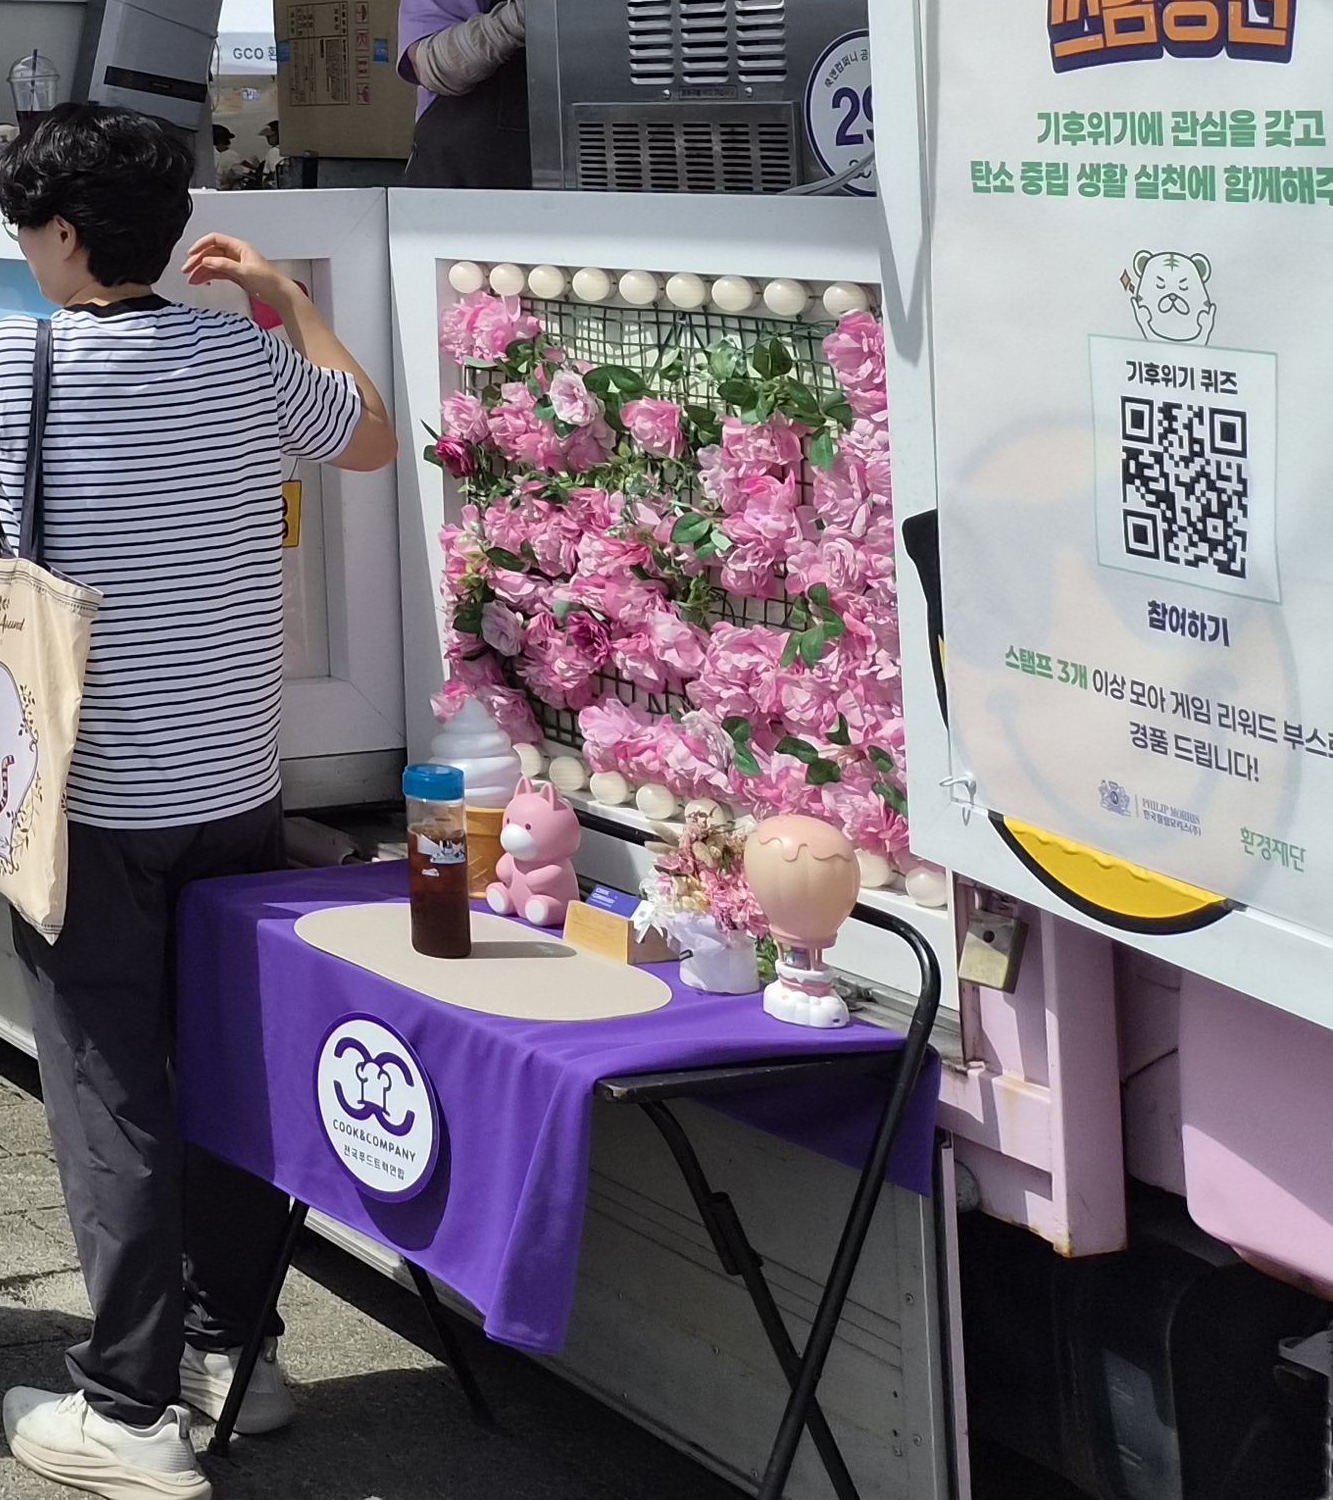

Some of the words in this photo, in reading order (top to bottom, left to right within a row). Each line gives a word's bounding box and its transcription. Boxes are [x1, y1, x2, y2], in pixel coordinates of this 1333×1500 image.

[233, 47, 264, 60] GCO
[1037, 111, 1164, 146] 기후위기에
[1171, 109, 1257, 147] 관심을
[1264, 110, 1326, 147] 갖고
[970, 160, 1015, 194] 탄소
[1019, 161, 1069, 196] 중립
[1076, 162, 1129, 198] 생활
[1134, 164, 1216, 201] 실천에
[1125, 360, 1195, 391] 기후위기
[1200, 368, 1238, 395] 퀴즈
[1147, 600, 1230, 647] 참여하기
[1005, 645, 1054, 680] 스탬프
[1057, 659, 1088, 690] 3개
[1092, 669, 1127, 701] 이상
[1129, 679, 1166, 713] 모아
[1170, 689, 1212, 725] 게임
[1217, 701, 1278, 744] 리워드
[1129, 720, 1169, 756] 경품
[1174, 733, 1259, 782] 드립니다!
[1142, 797, 1169, 817] PHILIP
[1170, 806, 1201, 825] MORRIS
[1240, 826, 1306, 872] 환경재단
[332, 1119, 416, 1163] COOK&COMPANY
[344, 1144, 405, 1181] 전국푸드트럭연합
